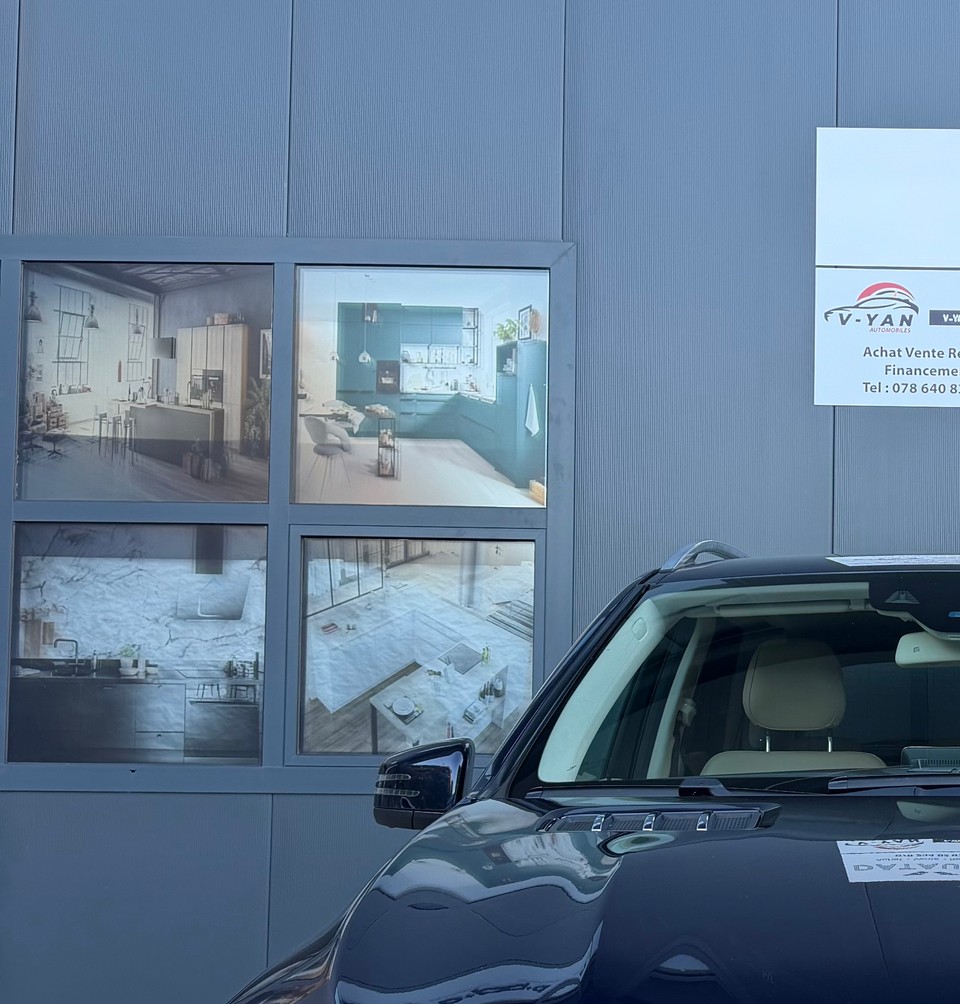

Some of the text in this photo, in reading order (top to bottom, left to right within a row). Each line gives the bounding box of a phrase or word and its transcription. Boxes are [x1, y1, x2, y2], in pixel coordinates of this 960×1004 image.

[839, 313, 913, 326] V-YAN
[863, 346, 902, 358] Achat
[905, 347, 945, 358] Vente
[863, 382, 882, 393] Tel
[892, 383, 917, 393] 078
[921, 383, 946, 394] 640
